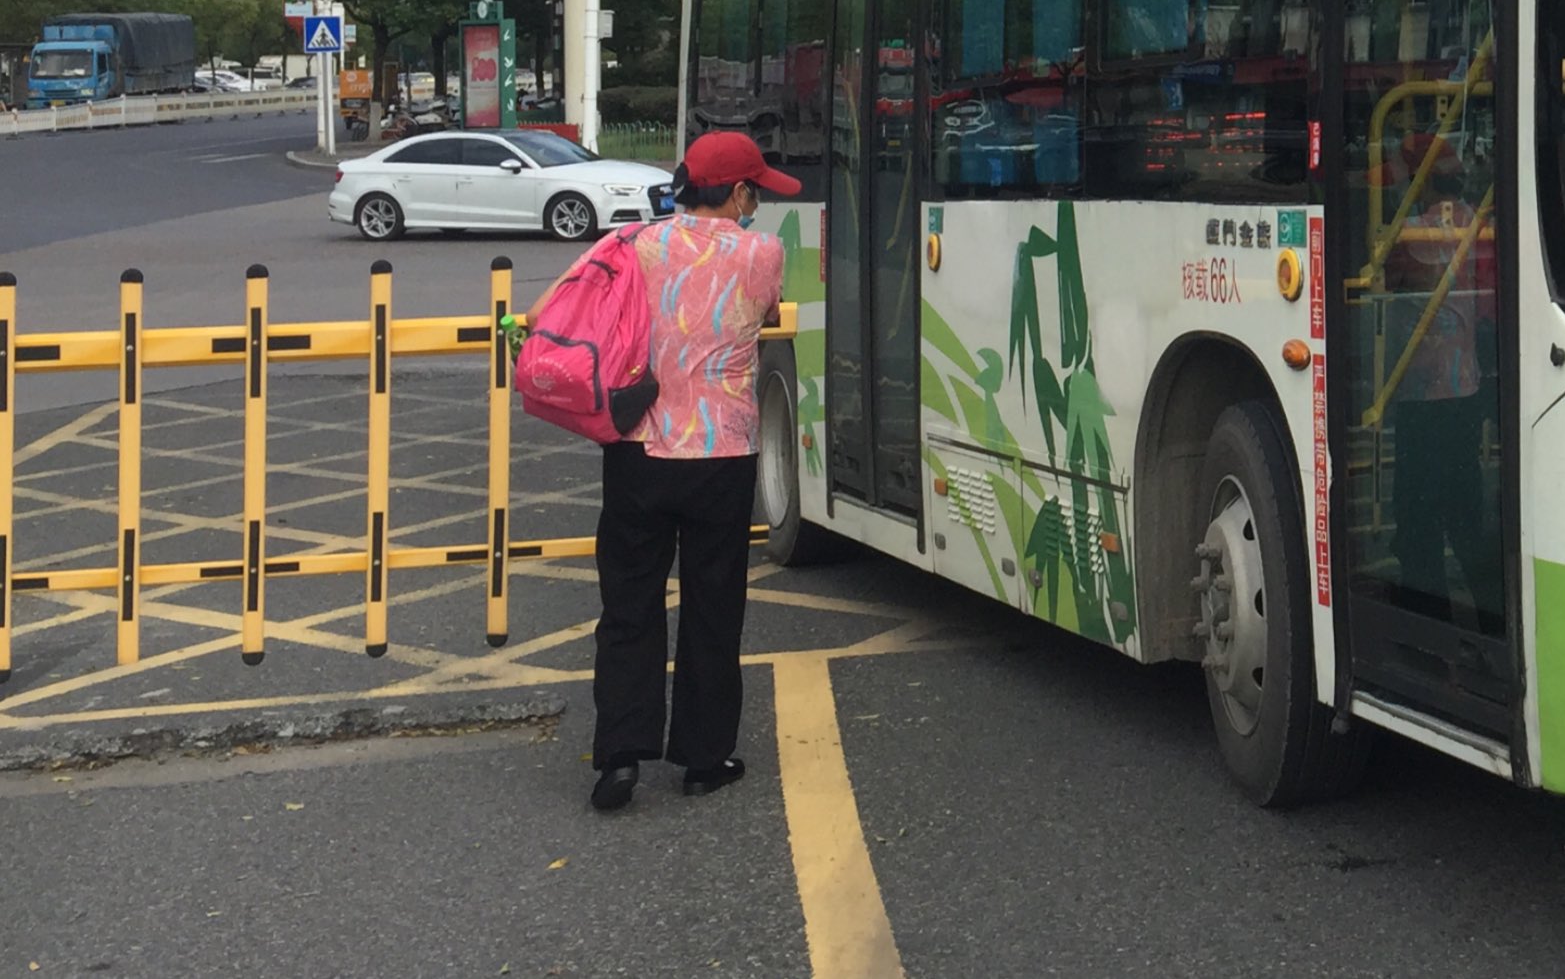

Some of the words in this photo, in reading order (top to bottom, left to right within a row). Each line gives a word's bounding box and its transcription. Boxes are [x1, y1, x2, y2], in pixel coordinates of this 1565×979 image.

[1182, 257, 1242, 305] 核载66人
[1310, 228, 1325, 330] 前门上车
